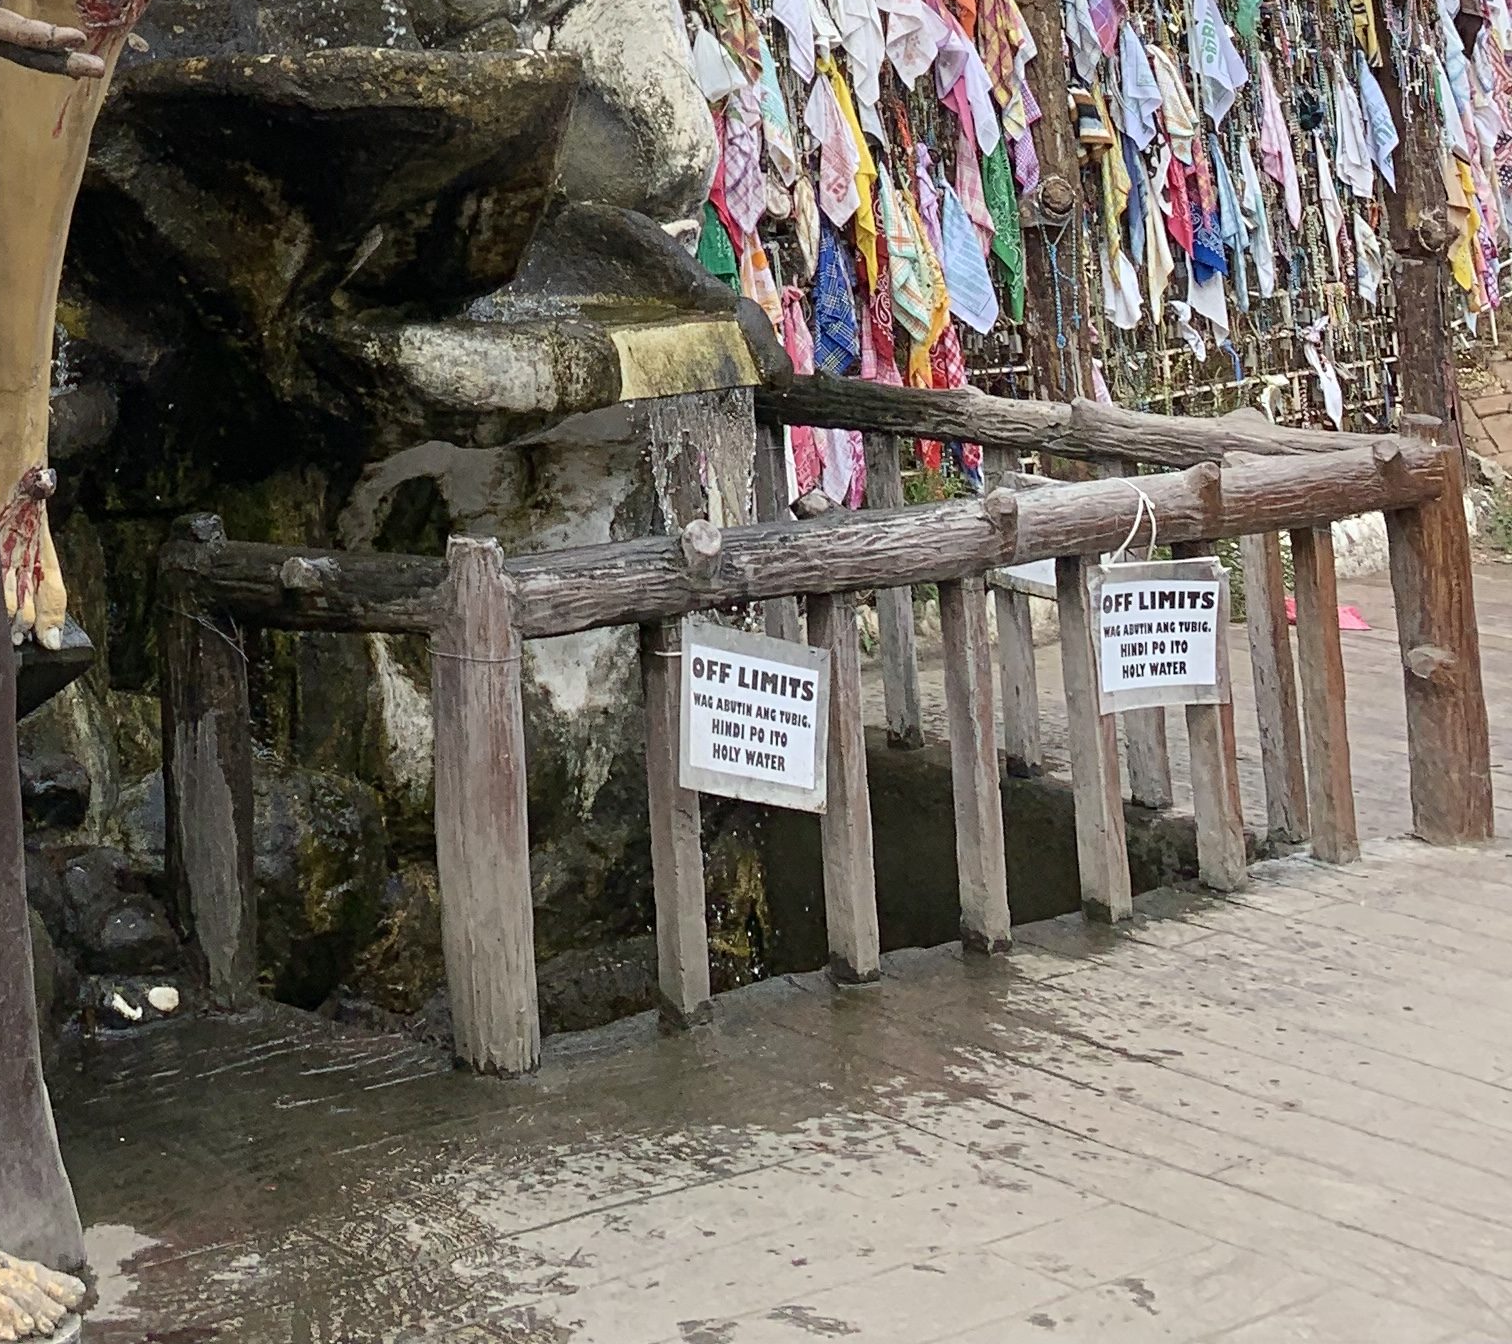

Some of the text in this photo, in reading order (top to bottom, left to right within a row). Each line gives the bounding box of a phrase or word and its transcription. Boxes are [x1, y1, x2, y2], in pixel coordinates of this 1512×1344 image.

[1103, 590, 1215, 614] OFF LIMITS
[1104, 620, 1212, 638] WAG ABUTIN ANG TUBIG.
[1120, 639, 1189, 658] HINDI PO ITO
[692, 656, 815, 702] OFF LIMITS
[1122, 661, 1187, 679] HOLY WATER
[693, 691, 811, 729] WAG ABUTIN ANG TUBIG.
[711, 718, 788, 748] HINDI PO ITO
[712, 742, 786, 772] HOLY WATER
